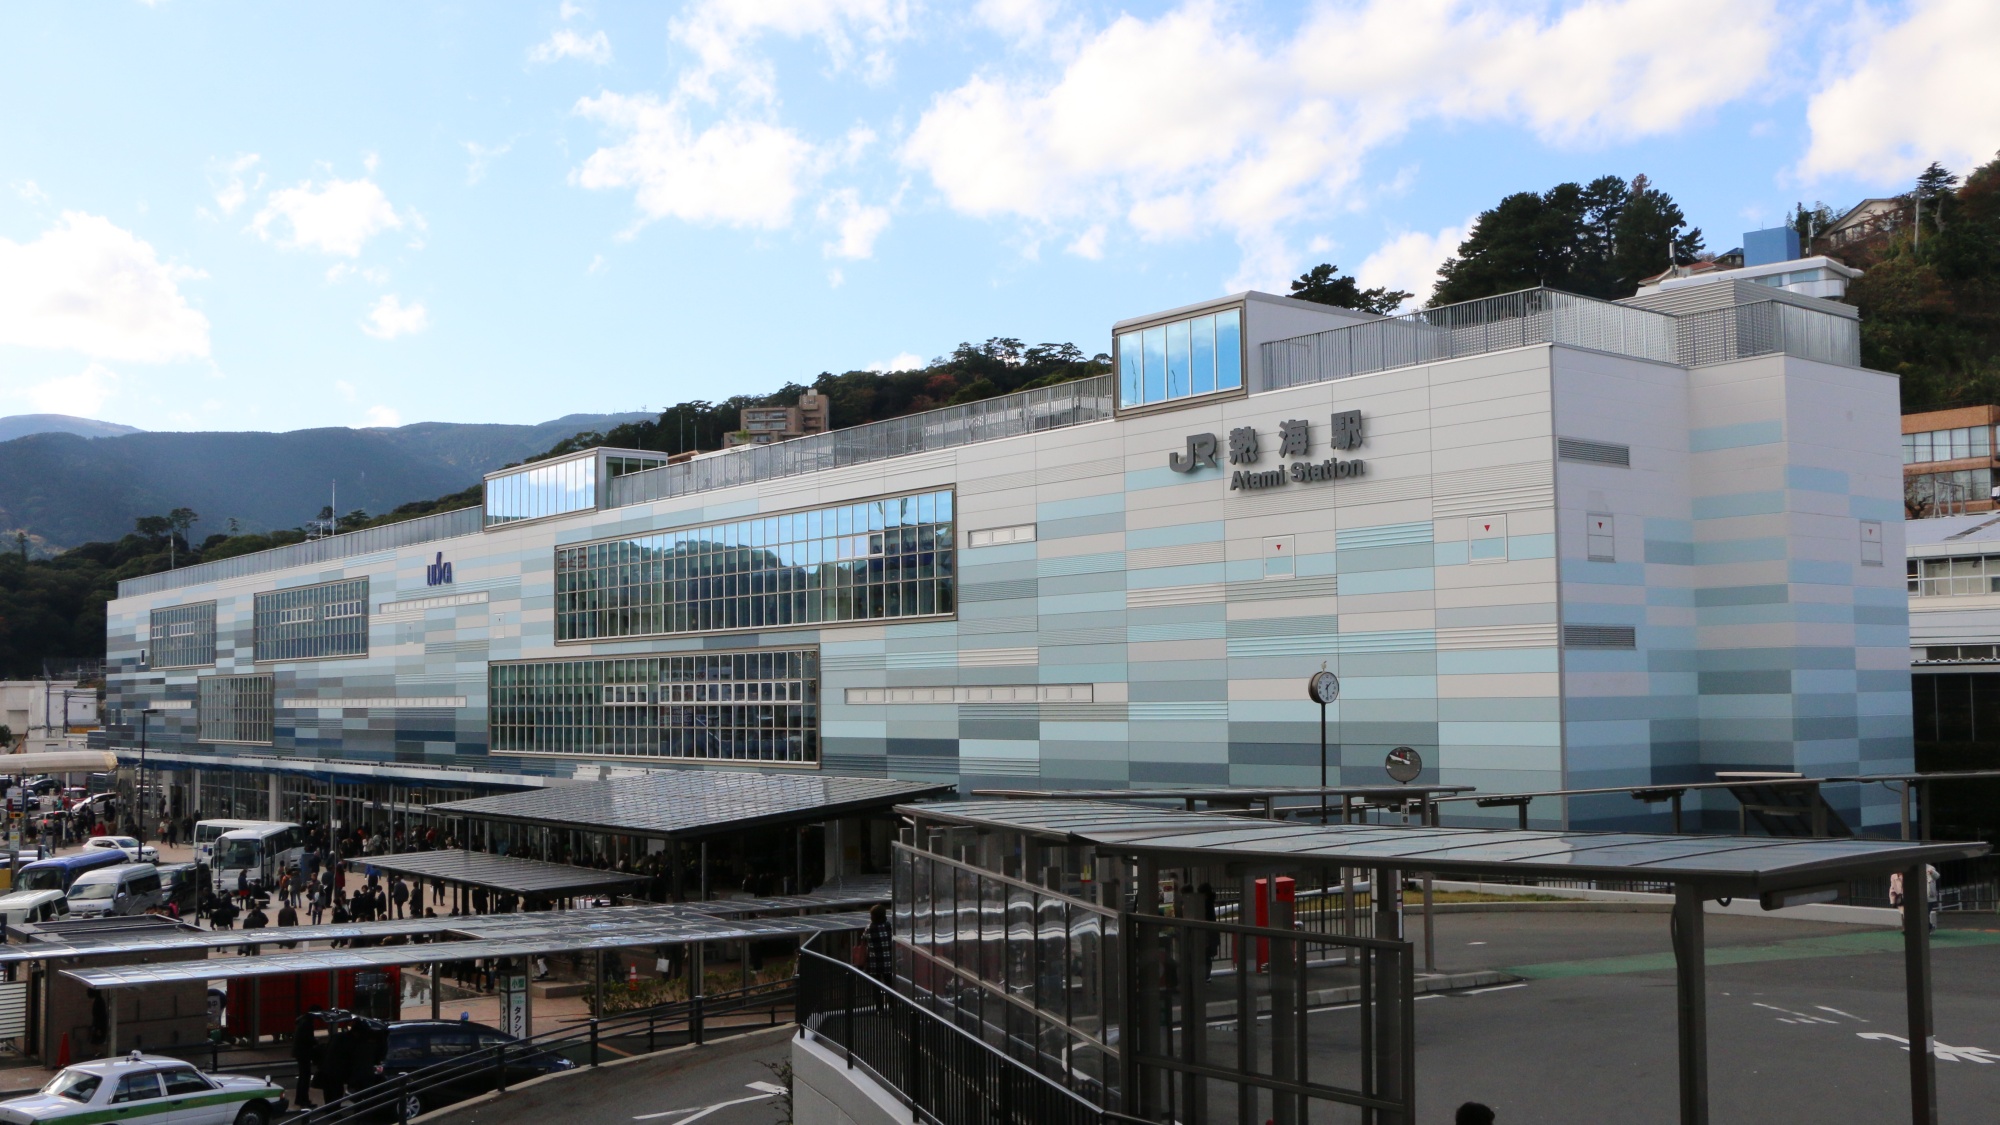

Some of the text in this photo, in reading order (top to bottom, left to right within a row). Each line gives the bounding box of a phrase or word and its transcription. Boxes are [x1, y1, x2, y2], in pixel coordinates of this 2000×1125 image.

[1169, 409, 1363, 474] JR 熱海駅
[1229, 457, 1366, 491] Atami Station
